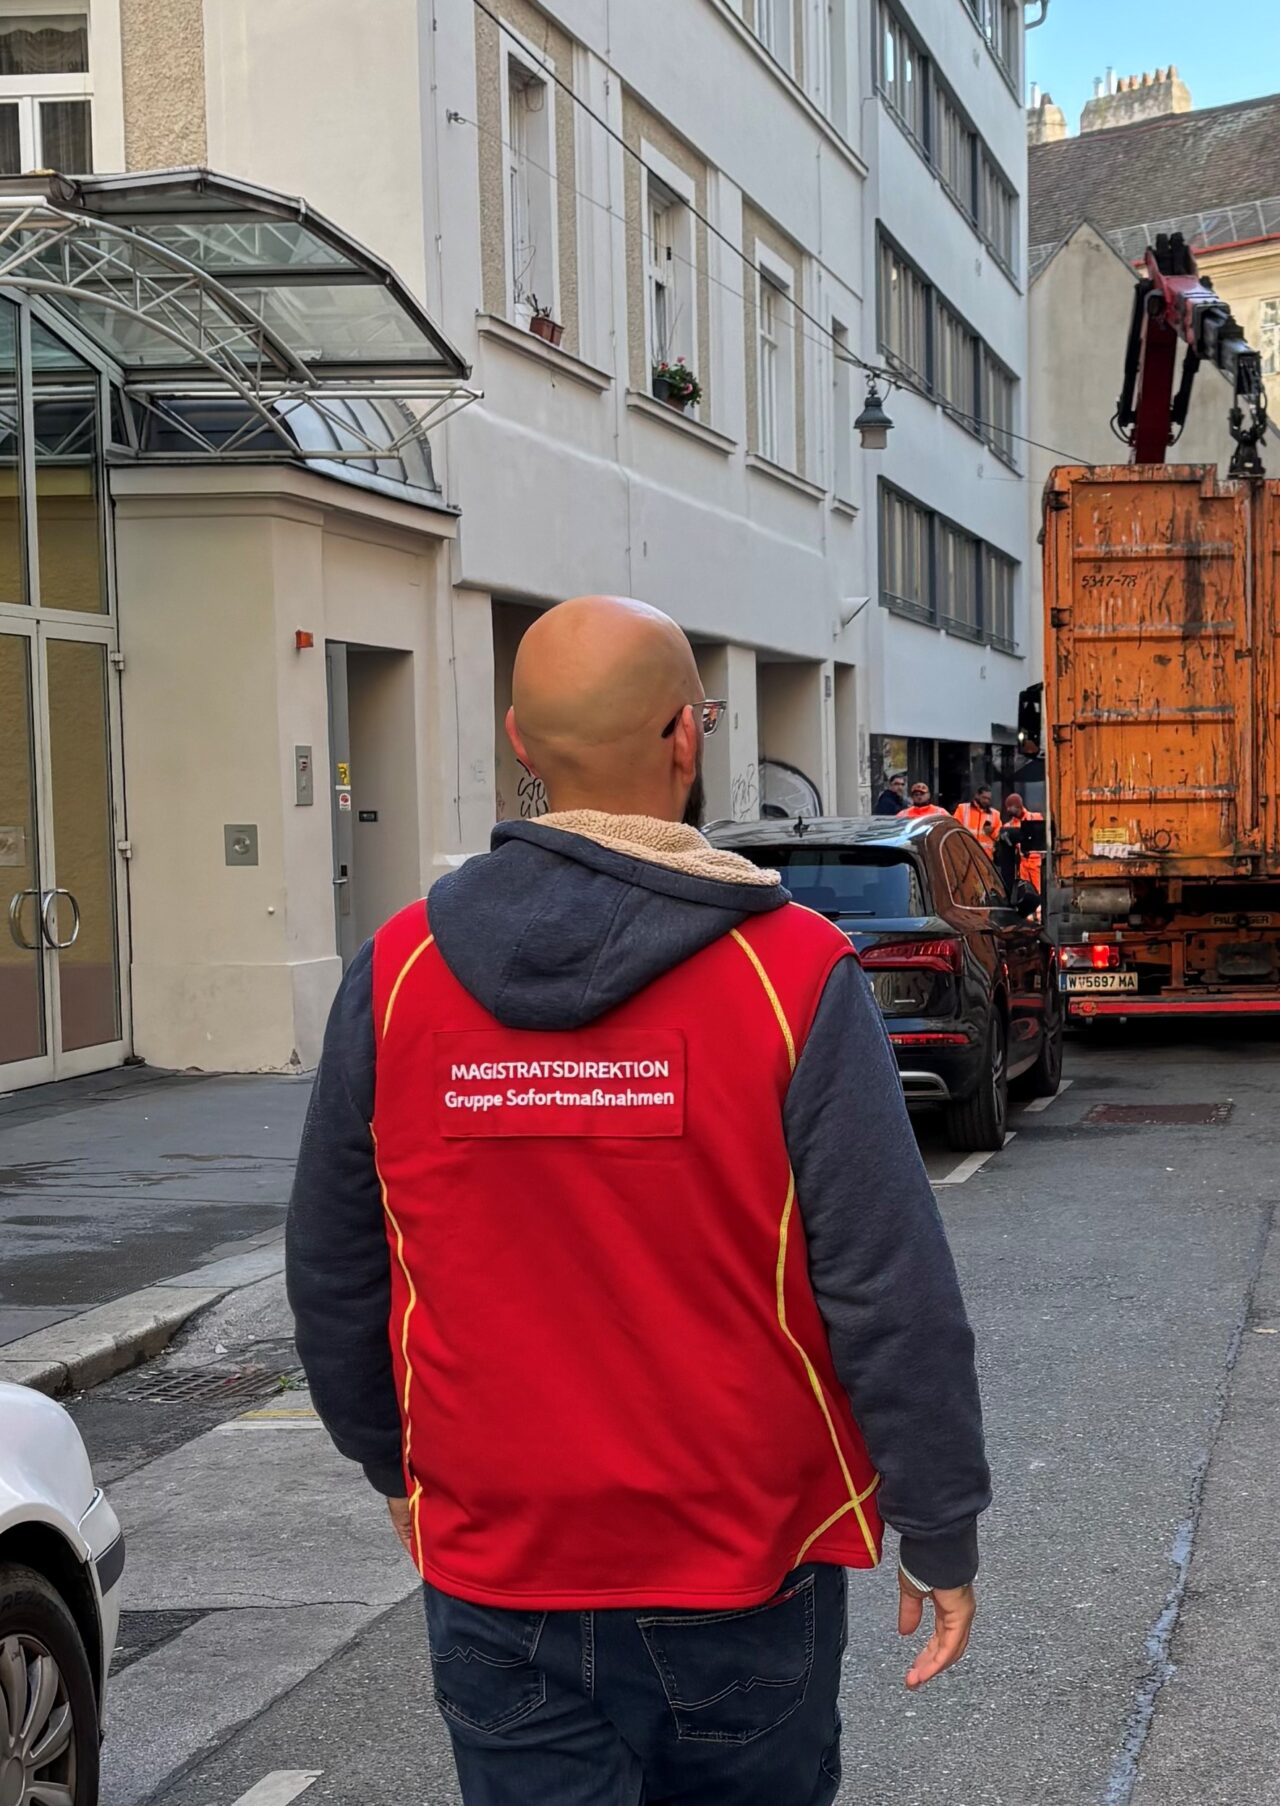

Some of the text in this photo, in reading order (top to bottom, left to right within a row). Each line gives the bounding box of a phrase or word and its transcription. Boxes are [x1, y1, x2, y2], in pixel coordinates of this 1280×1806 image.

[1068, 976, 1135, 988] W 5697 MA
[451, 1060, 669, 1080] MAGISTRATSDIREKTION
[444, 1088, 675, 1112] Gruppe Sofortmaßnahmen
